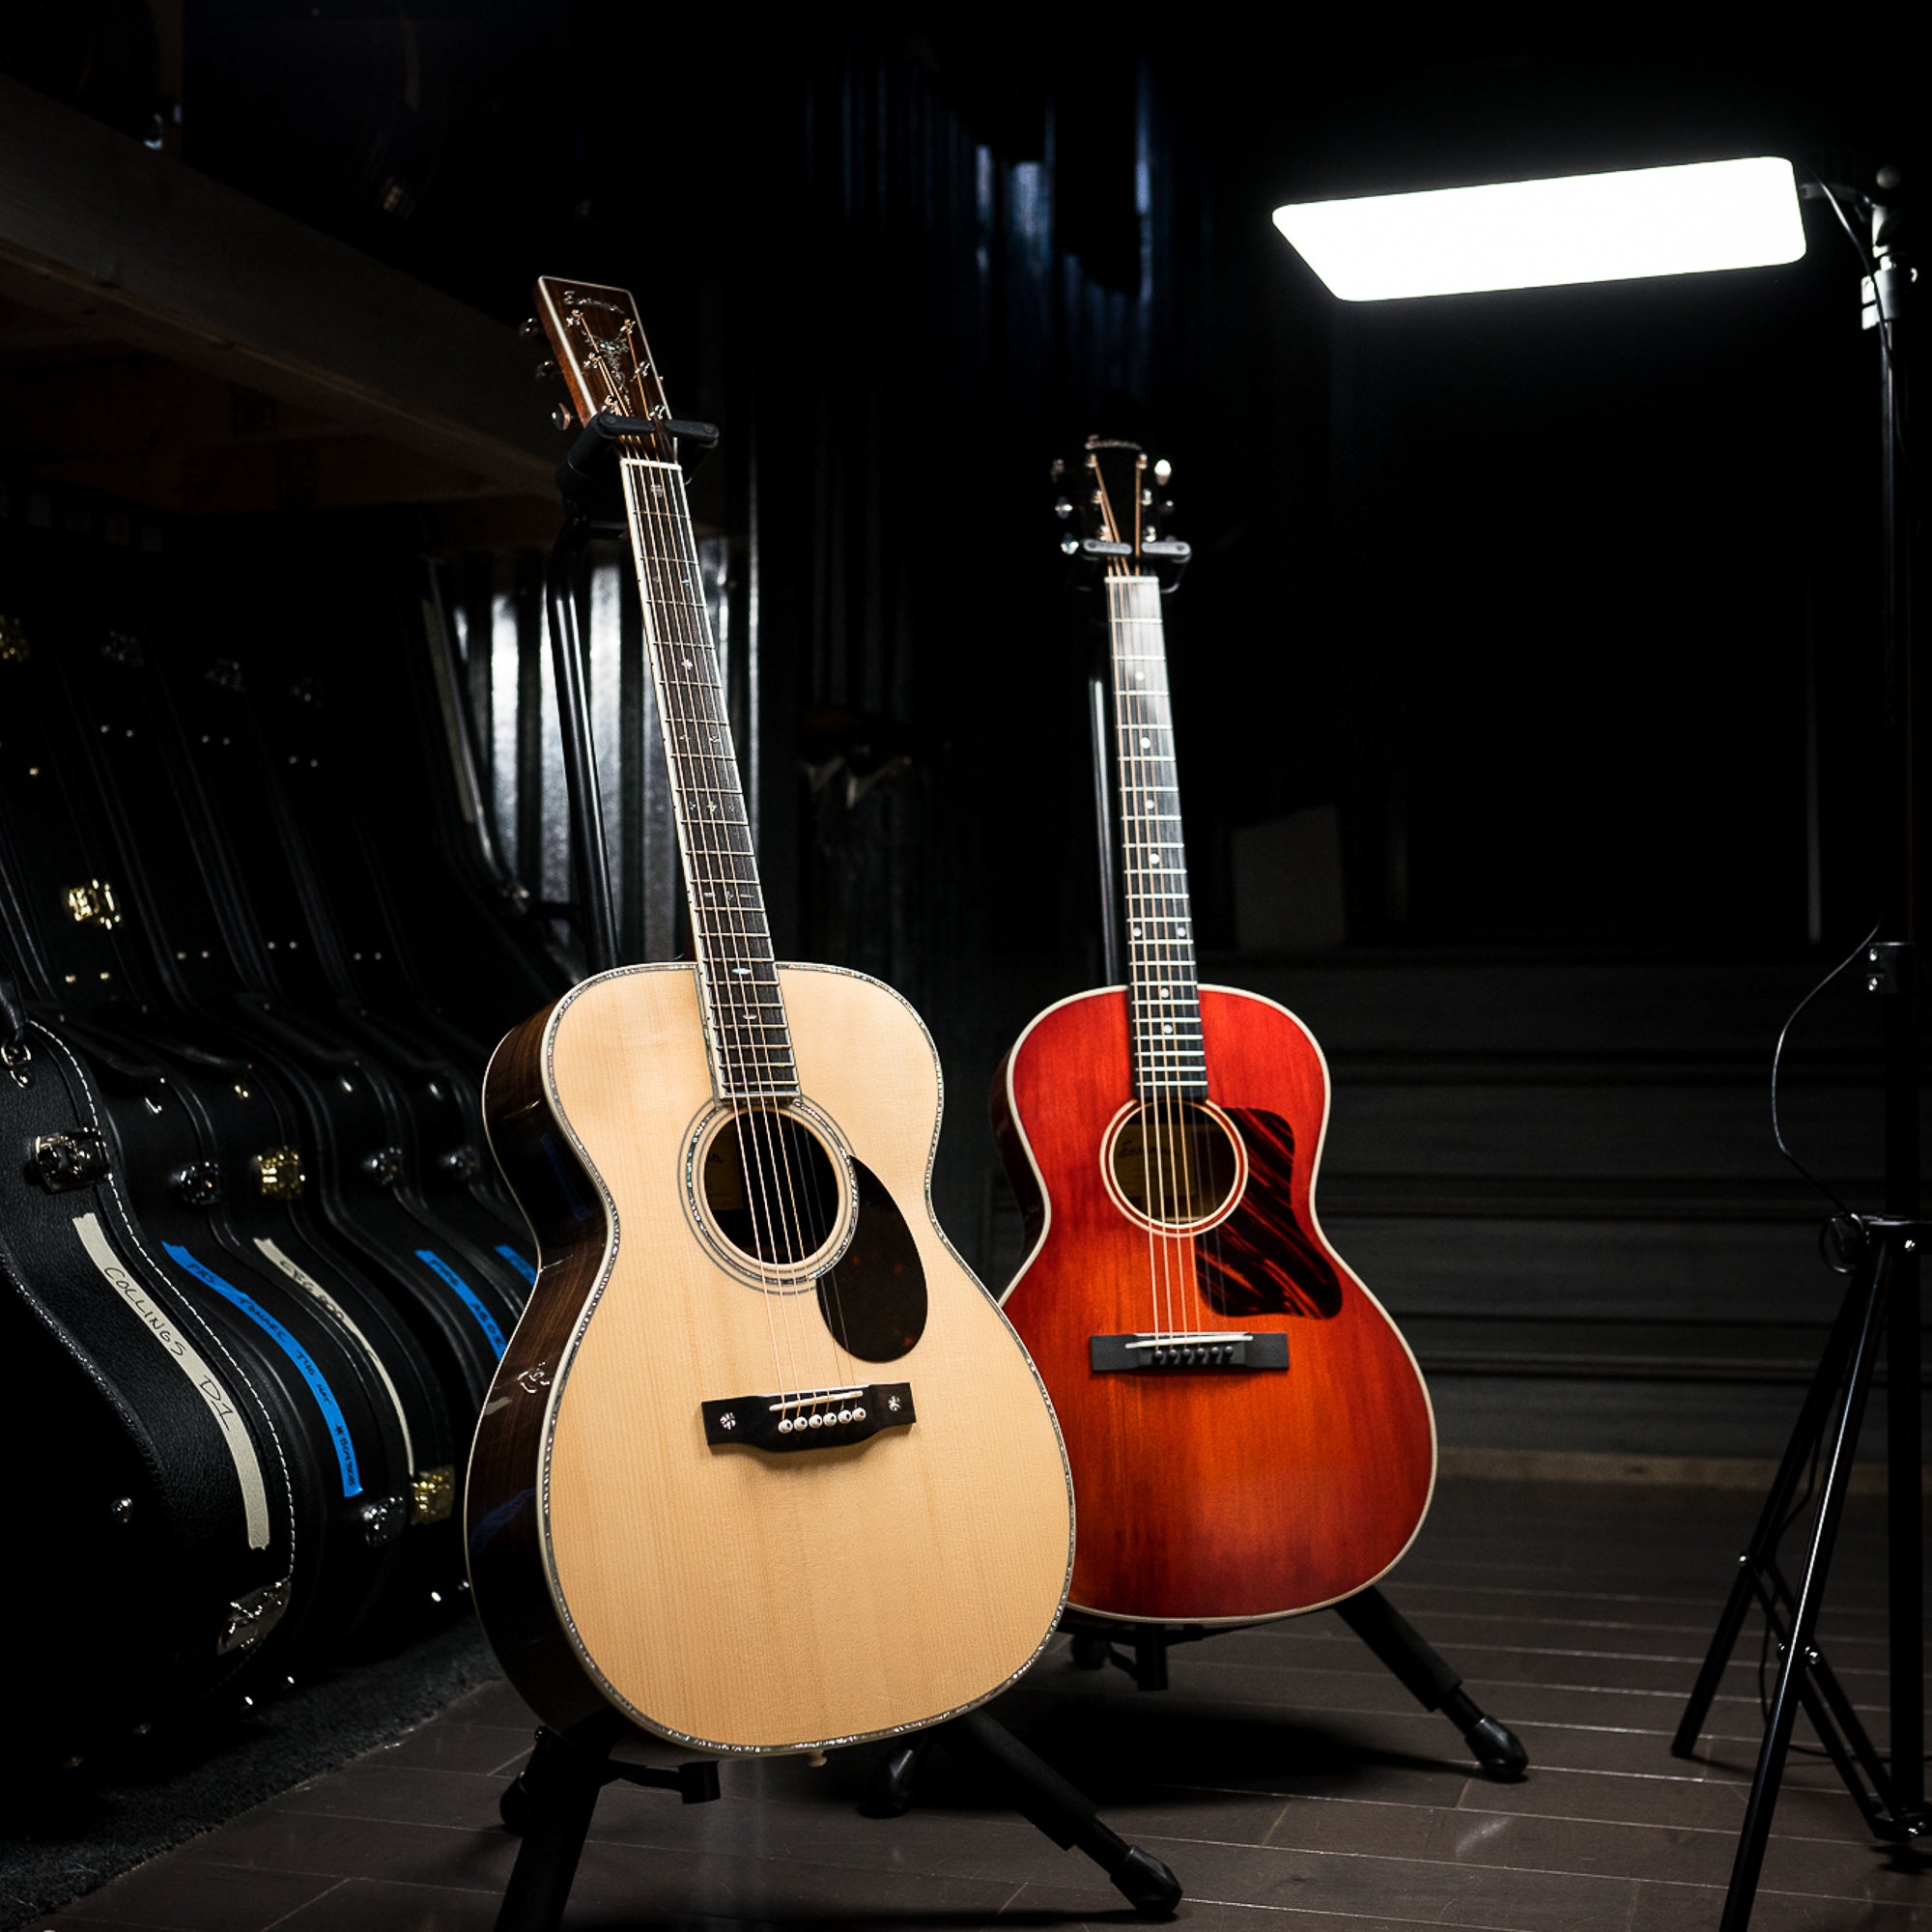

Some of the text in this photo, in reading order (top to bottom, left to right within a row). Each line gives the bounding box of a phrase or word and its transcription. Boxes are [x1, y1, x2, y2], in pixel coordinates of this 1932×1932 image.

[186, 1262, 216, 1285] PRS
[102, 1265, 235, 1432] COLLINGS D1
